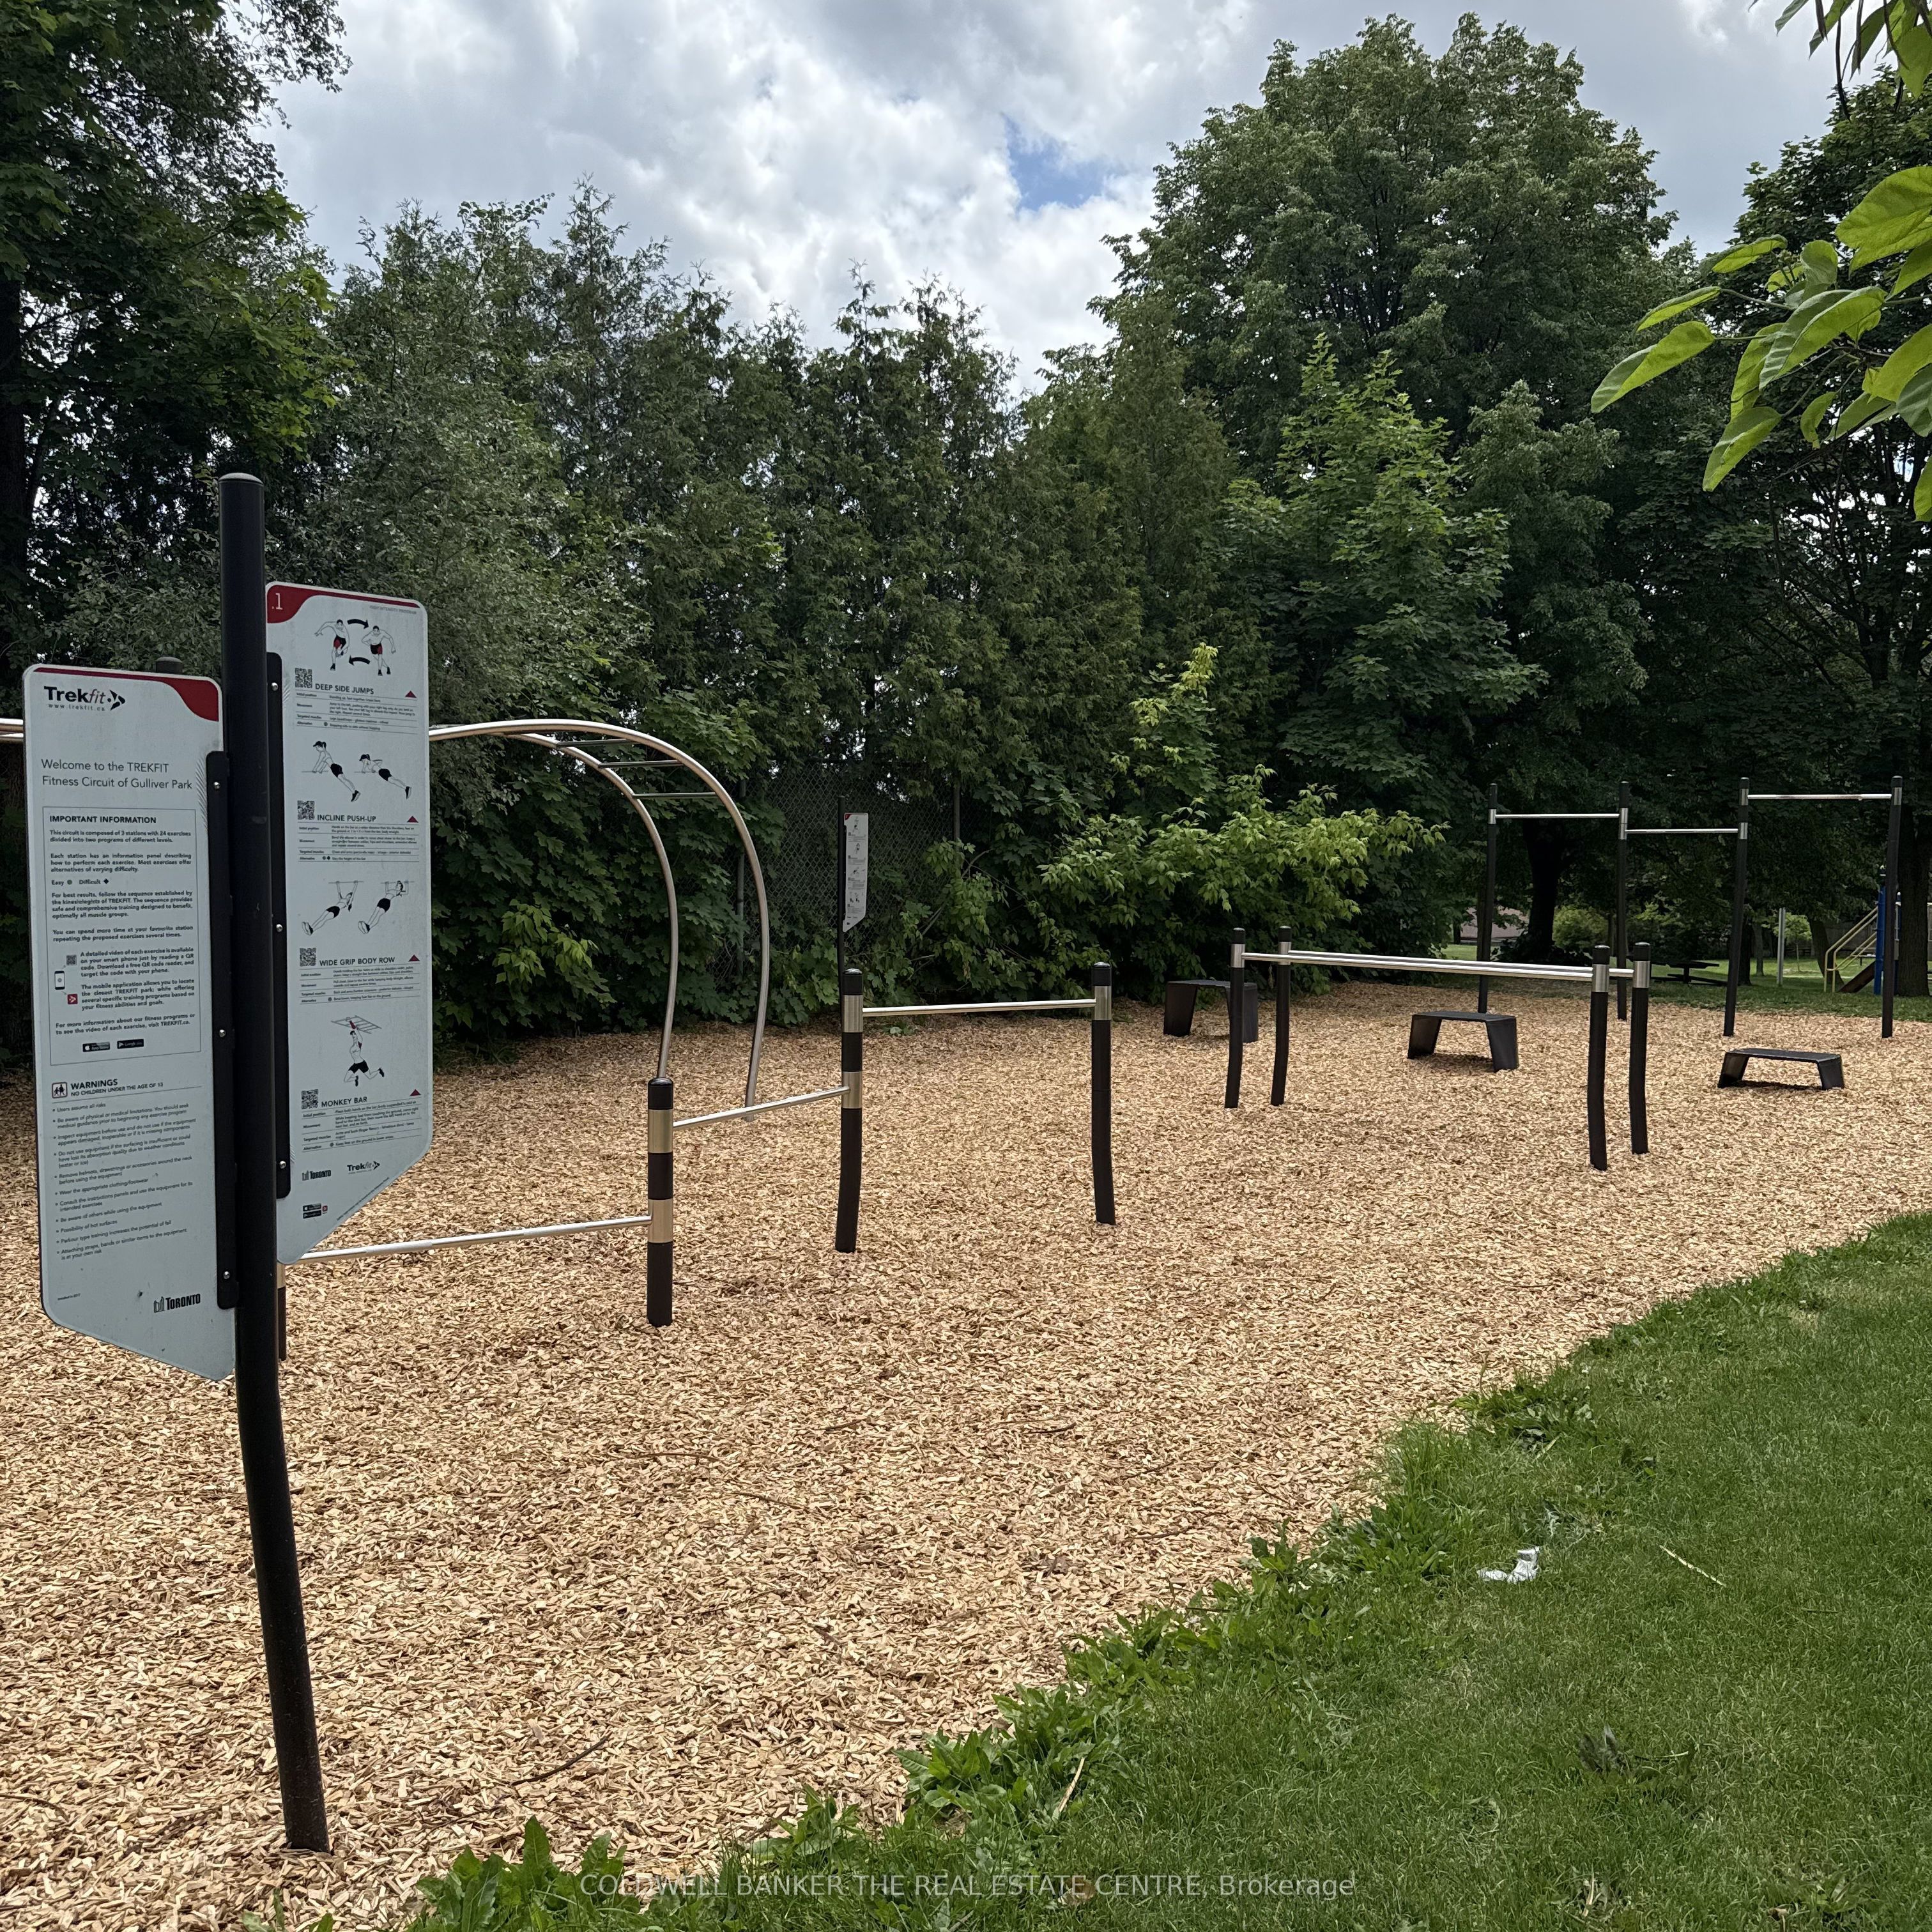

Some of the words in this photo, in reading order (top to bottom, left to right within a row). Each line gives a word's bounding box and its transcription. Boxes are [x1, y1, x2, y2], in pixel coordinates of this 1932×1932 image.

[43, 686, 106, 703] Trekfit
[42, 759, 91, 770] Welcome
[95, 762, 104, 770] to
[108, 762, 124, 771] the
[128, 762, 169, 772] TREKFIT
[42, 776, 79, 786] Fitness
[82, 777, 114, 787] Circuit
[118, 777, 128, 788] of
[131, 778, 169, 788] Gulliver
[172, 779, 192, 789] Park
[71, 1078, 118, 1090] WARNINGS
[321, 1098, 352, 1107] MONKEY
[165, 1294, 201, 1310] TORONTO
